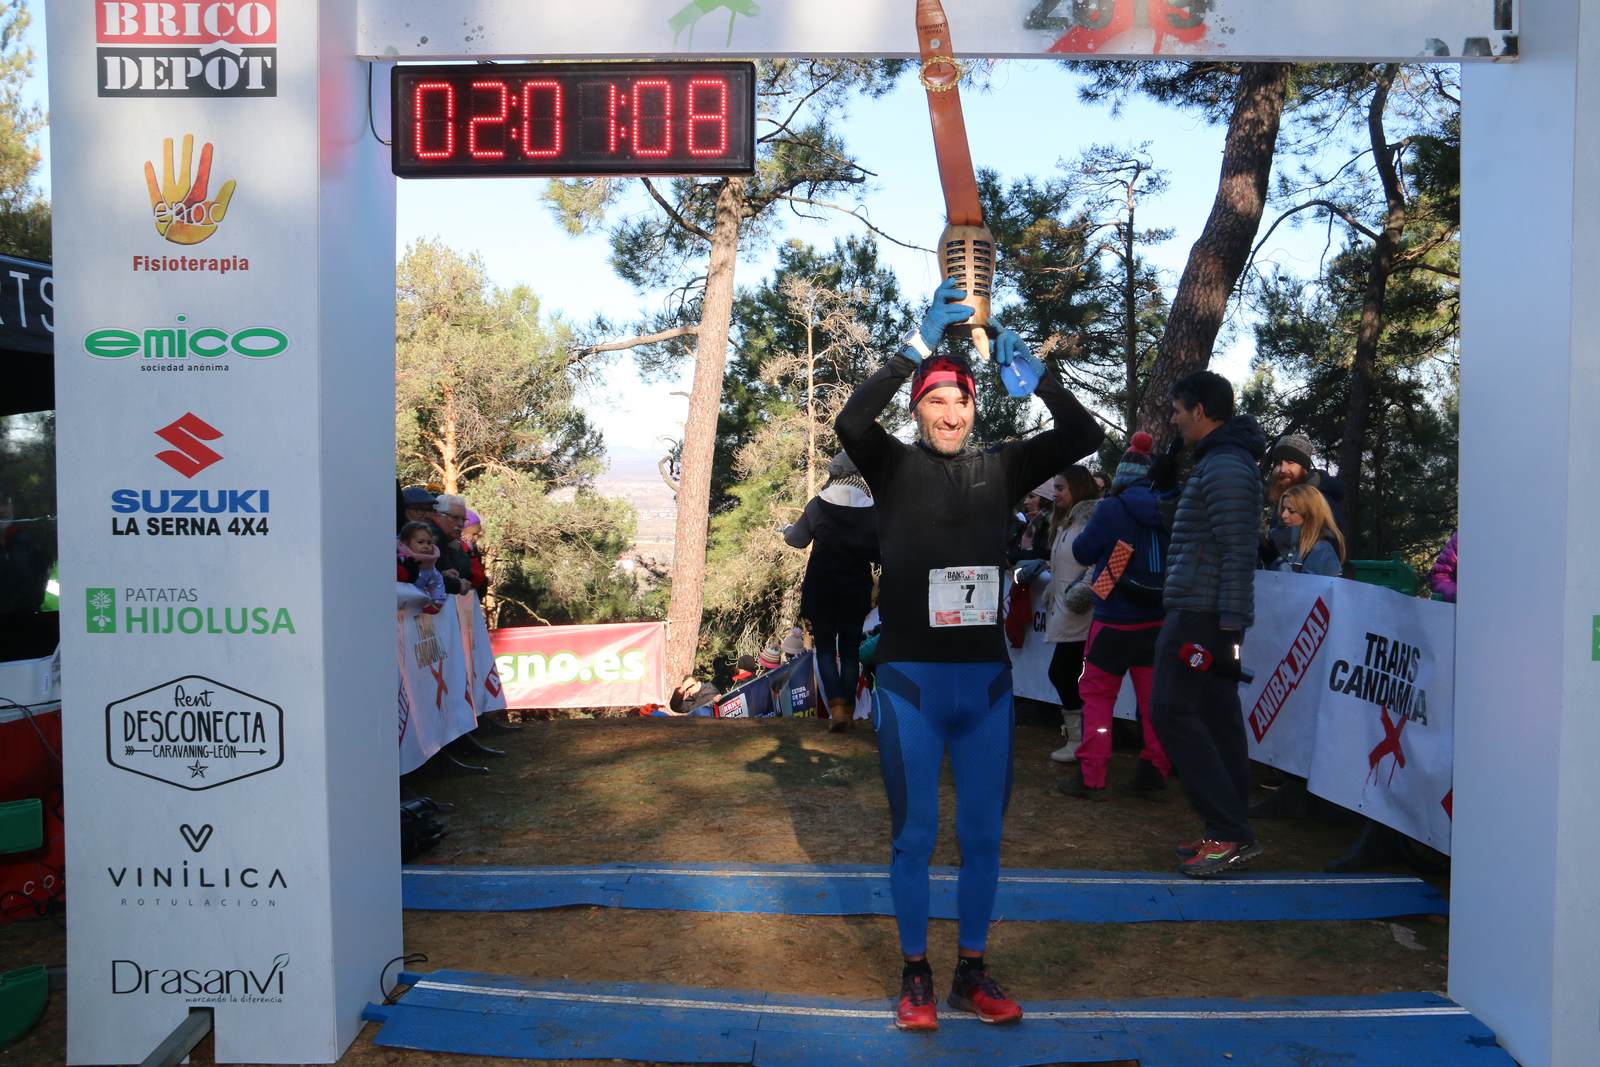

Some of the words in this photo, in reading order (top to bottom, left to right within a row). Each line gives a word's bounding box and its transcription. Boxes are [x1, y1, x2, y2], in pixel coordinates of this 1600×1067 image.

[103, 2, 271, 36] BRICO
[133, 255, 249, 274] Fisioterapia
[84, 315, 288, 358] emico
[141, 363, 184, 372] sociedad
[187, 362, 229, 372] anónima
[111, 489, 270, 514] SUZUKI
[112, 517, 140, 536] LA
[147, 517, 222, 536] SERNA
[227, 517, 269, 536] 4X4
[126, 588, 198, 602] PATATAS
[965, 584, 976, 604] 7
[126, 607, 296, 634] HIJOLUSA
[496, 650, 646, 683] sno.es
[1365, 632, 1421, 683] TRANS
[174, 685, 215, 707] Rent
[1329, 659, 1428, 727] CANDAMIA
[124, 710, 266, 743] DESCONECTA
